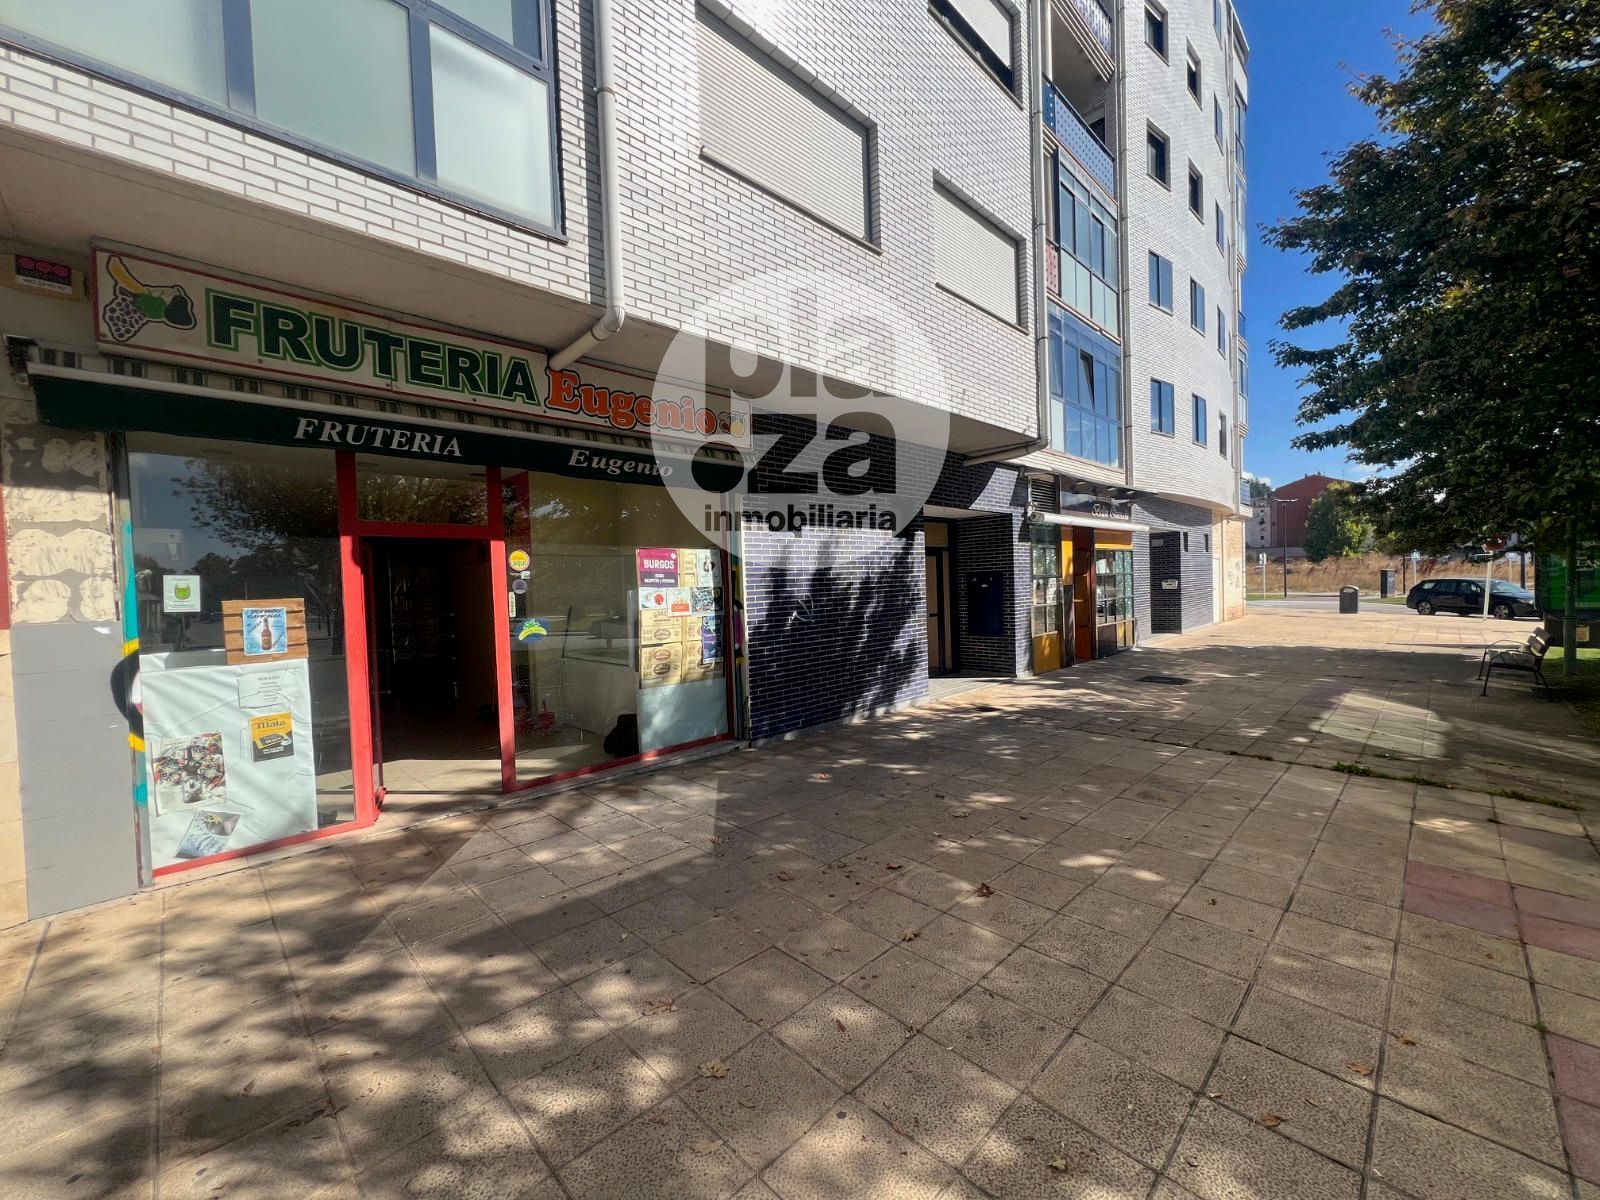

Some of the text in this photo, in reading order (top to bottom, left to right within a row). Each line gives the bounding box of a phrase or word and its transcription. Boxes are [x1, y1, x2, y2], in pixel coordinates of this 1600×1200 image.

[206, 289, 718, 436] FRUTERIA Eugenio
[293, 417, 673, 478] FRUTERIA Eugenio
[643, 559, 675, 570] BURGOS
